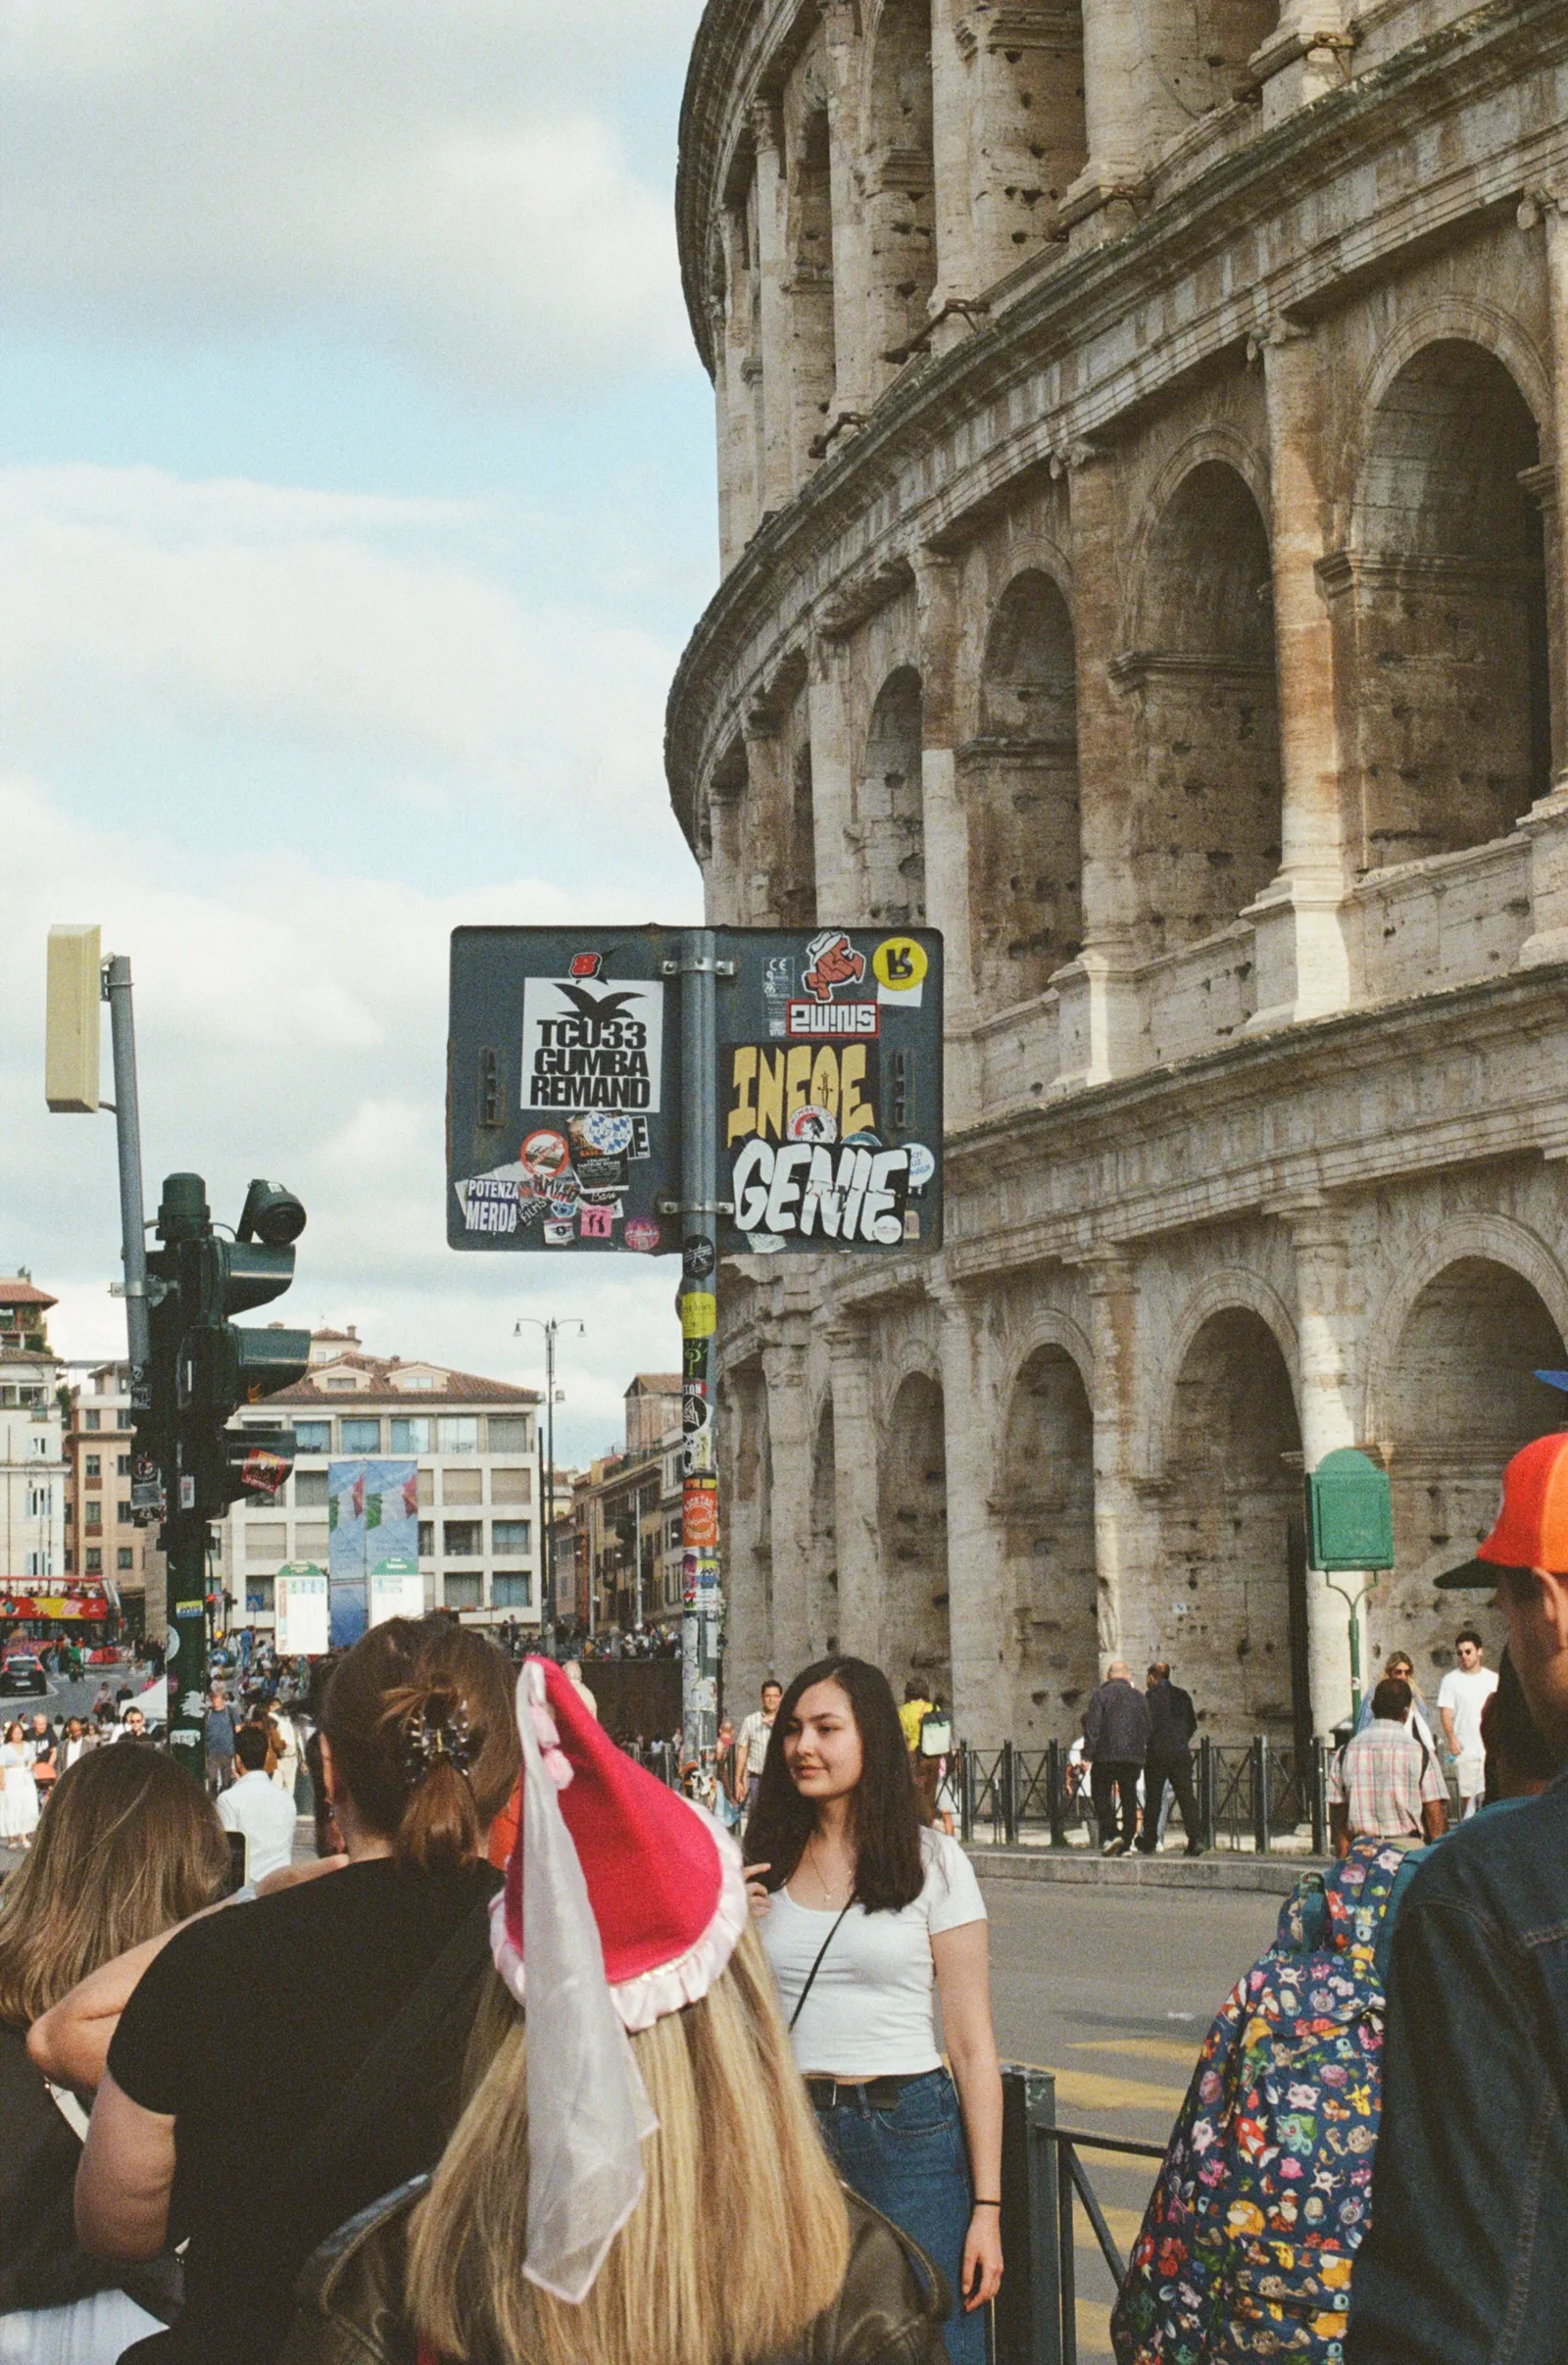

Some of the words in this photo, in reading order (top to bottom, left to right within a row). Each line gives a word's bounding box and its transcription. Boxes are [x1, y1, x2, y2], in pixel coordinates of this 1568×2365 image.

[537, 1019, 647, 1050] TCU33
[534, 1048, 649, 1077] GUMBA
[529, 1075, 651, 1109] REMAND
[468, 1179, 519, 1200] POTENZA
[733, 1138, 908, 1242] GENIE
[466, 1201, 517, 1233] MERDA
[520, 1198, 547, 1223] FILMS
